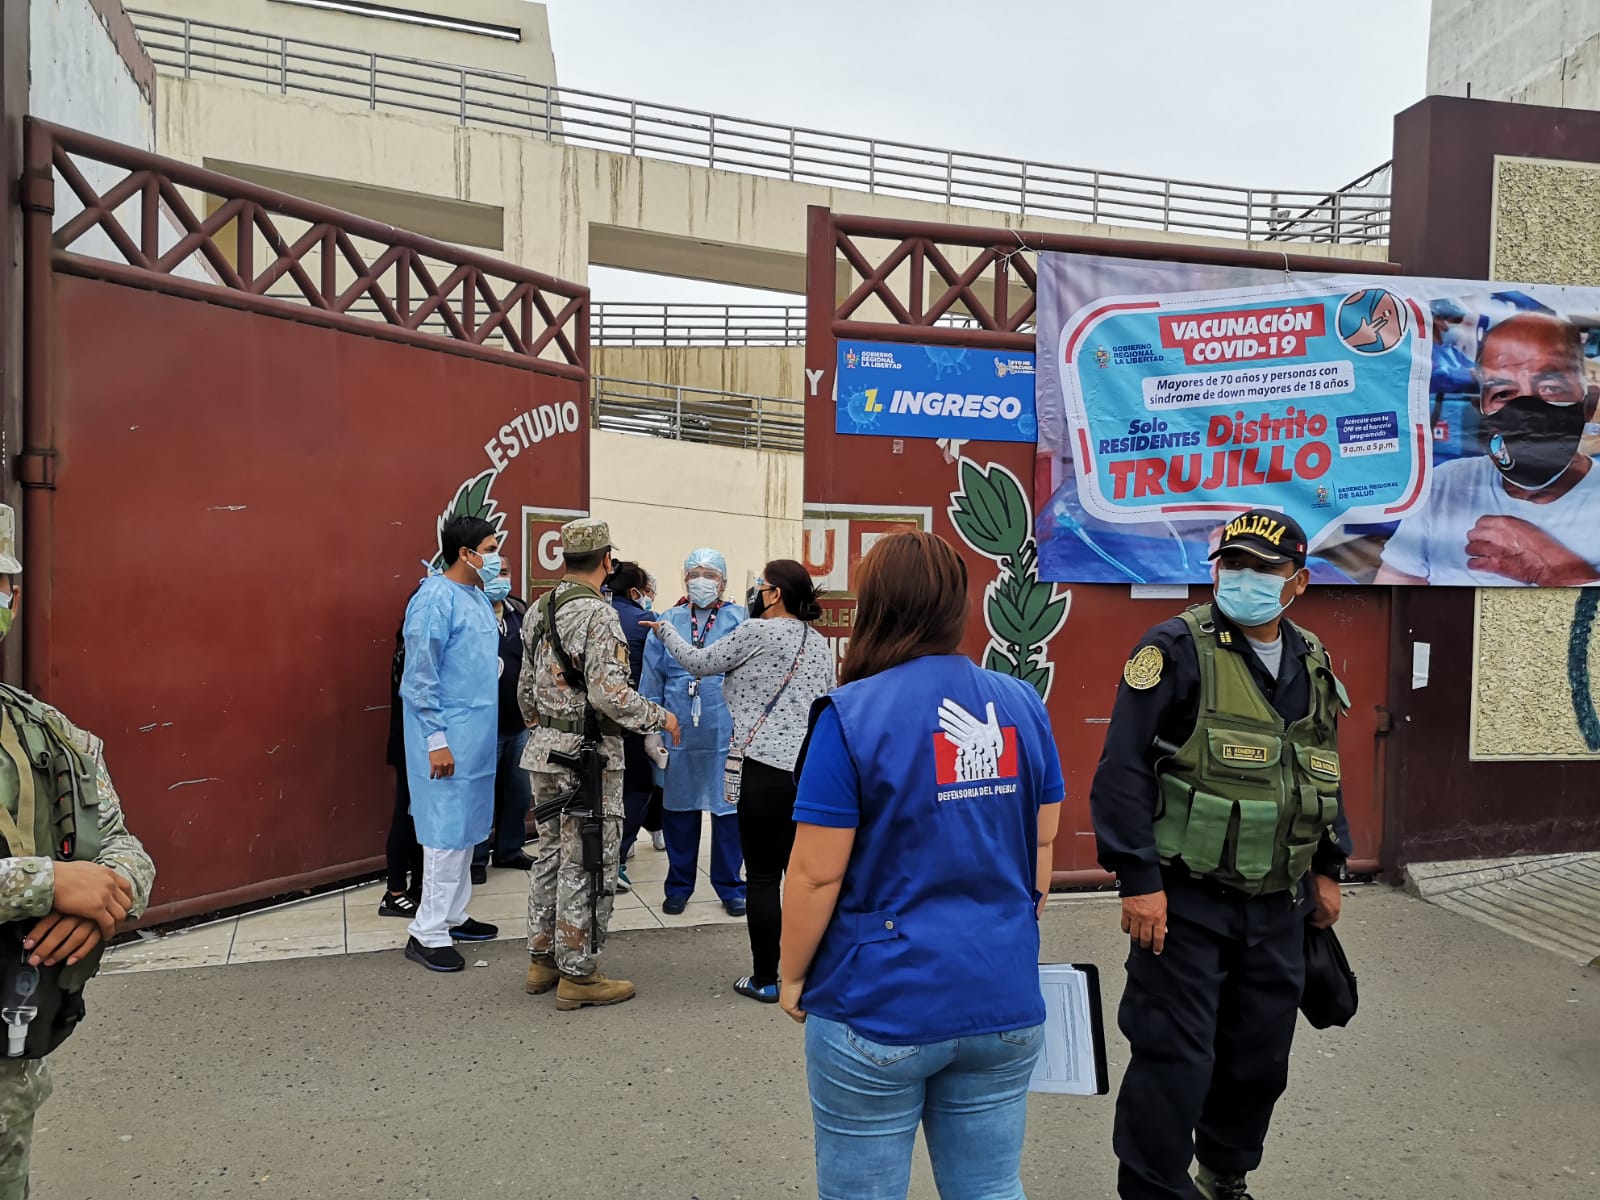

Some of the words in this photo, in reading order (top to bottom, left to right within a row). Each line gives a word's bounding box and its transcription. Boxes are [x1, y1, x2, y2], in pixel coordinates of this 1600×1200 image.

[1171, 307, 1312, 340] VACUNACIÓN
[1112, 343, 1152, 352] GOBIERNO
[1113, 350, 1155, 358] REGIONAL
[1125, 355, 1165, 364] LIBERTAD
[1192, 335, 1297, 361] COVID-19
[871, 361, 902, 369] LIBERTAD
[1157, 379, 1204, 391] Mayores
[1206, 376, 1218, 386] de
[1220, 374, 1233, 385] 70
[1235, 373, 1260, 383] años
[1262, 373, 1268, 383] y
[1270, 367, 1317, 382] personas
[1319, 366, 1338, 376] con
[1150, 392, 1201, 404] síndrome
[1202, 390, 1215, 400] de
[1217, 389, 1246, 398] down
[1247, 384, 1292, 397] mayores
[1294, 382, 1306, 392] de
[1310, 380, 1321, 390] 18
[1323, 379, 1349, 389] años
[864, 388, 883, 412] 1.
[889, 390, 1022, 420] INGRESO
[484, 401, 579, 473] ESTUDIO
[1128, 417, 1168, 435] Solo
[1206, 406, 1328, 447] Distrito
[1099, 431, 1201, 454] RESIDENTES
[1379, 442, 1396, 451] p.m.
[1109, 441, 1332, 500] TRUJILLO
[1351, 490, 1374, 498] SALUD
[1225, 516, 1286, 545] POLICIA
[938, 788, 980, 801] DEFENSORIA
[980, 786, 993, 796] DEL
[995, 784, 1017, 794] PUEBLO
